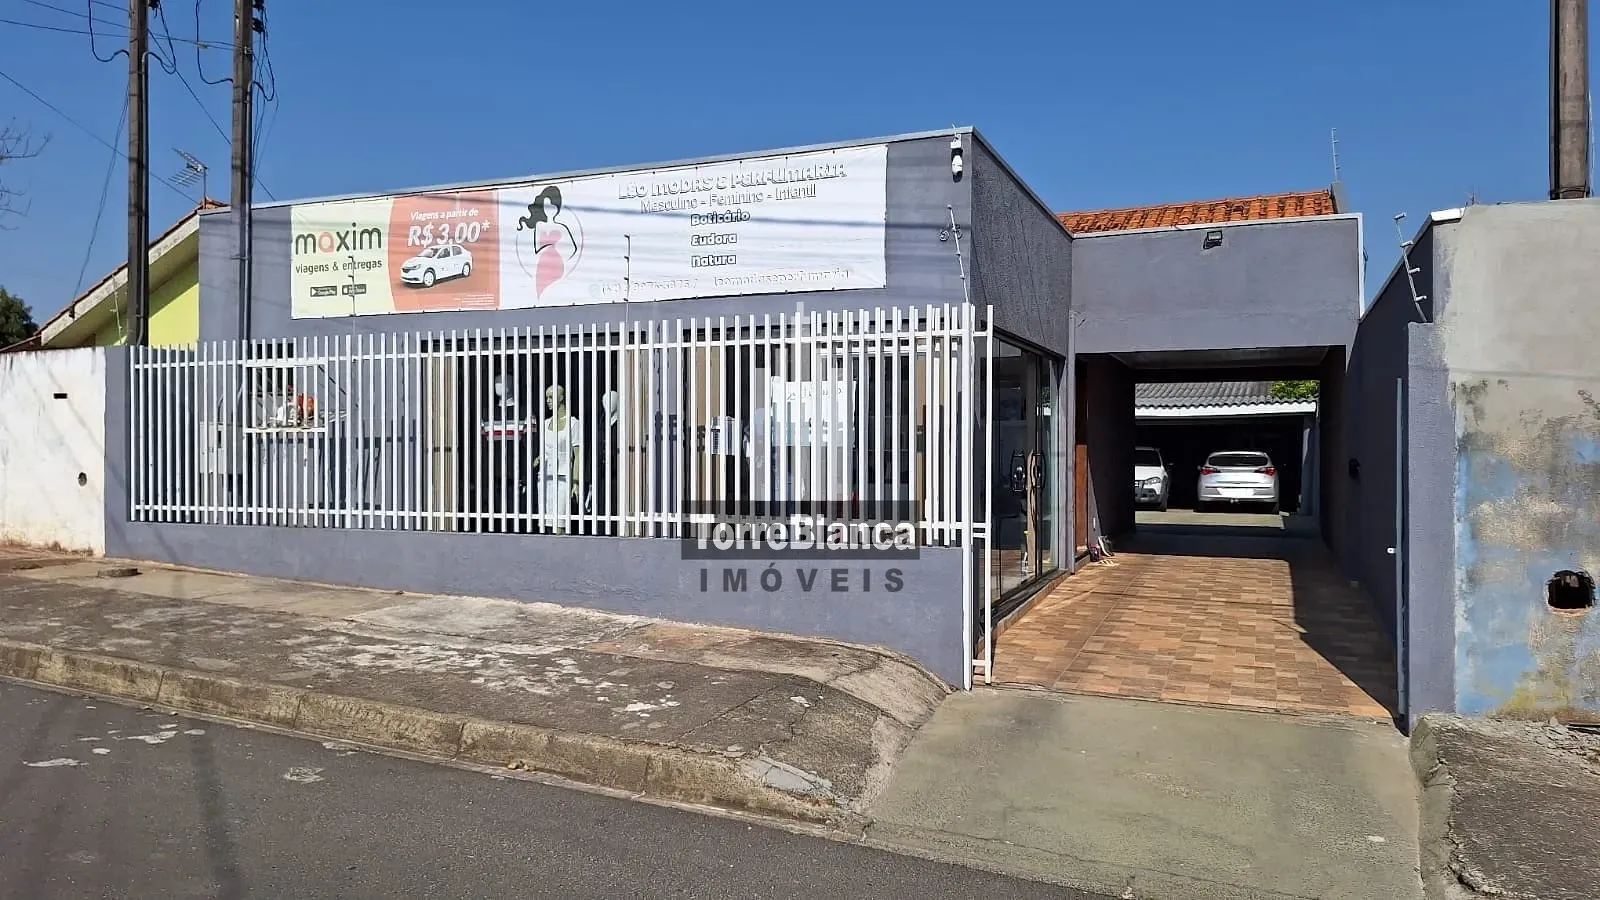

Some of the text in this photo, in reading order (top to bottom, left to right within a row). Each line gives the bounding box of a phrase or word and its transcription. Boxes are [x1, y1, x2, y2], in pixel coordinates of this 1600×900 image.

[410, 207, 480, 221] Viagens a partir de
[691, 209, 750, 226] Boticário
[295, 222, 382, 255] maxim
[407, 221, 434, 248] R$
[691, 233, 737, 246] Eudora
[295, 260, 383, 275] viagens & entregas
